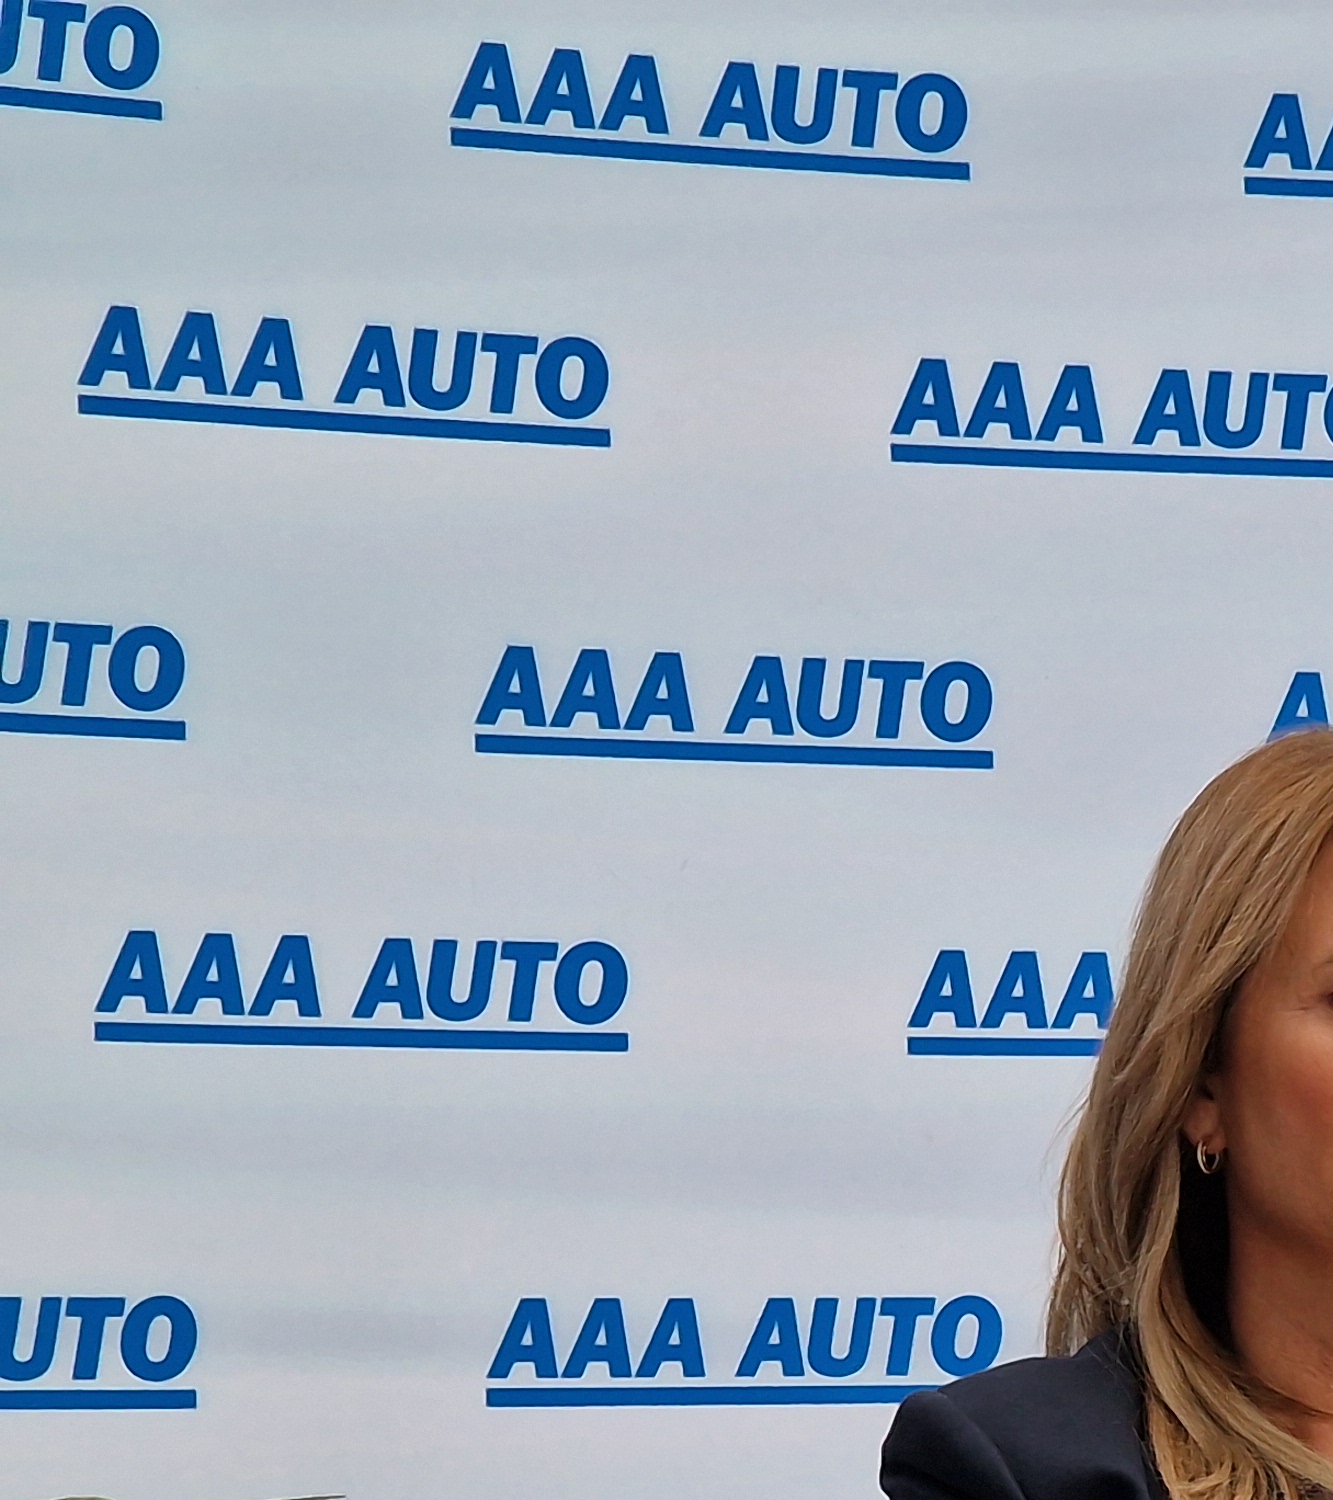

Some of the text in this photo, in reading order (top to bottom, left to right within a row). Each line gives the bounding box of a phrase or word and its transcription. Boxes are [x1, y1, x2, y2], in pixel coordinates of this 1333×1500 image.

[451, 42, 968, 154] AAA AUTO
[79, 305, 609, 420] AAA AUTO
[892, 358, 1104, 444] AAA
[476, 645, 993, 743] AAA AUTO
[96, 930, 629, 1026] AAA AUTO
[909, 949, 1114, 1030] AAA
[488, 1295, 1003, 1379] AAA AUTO
